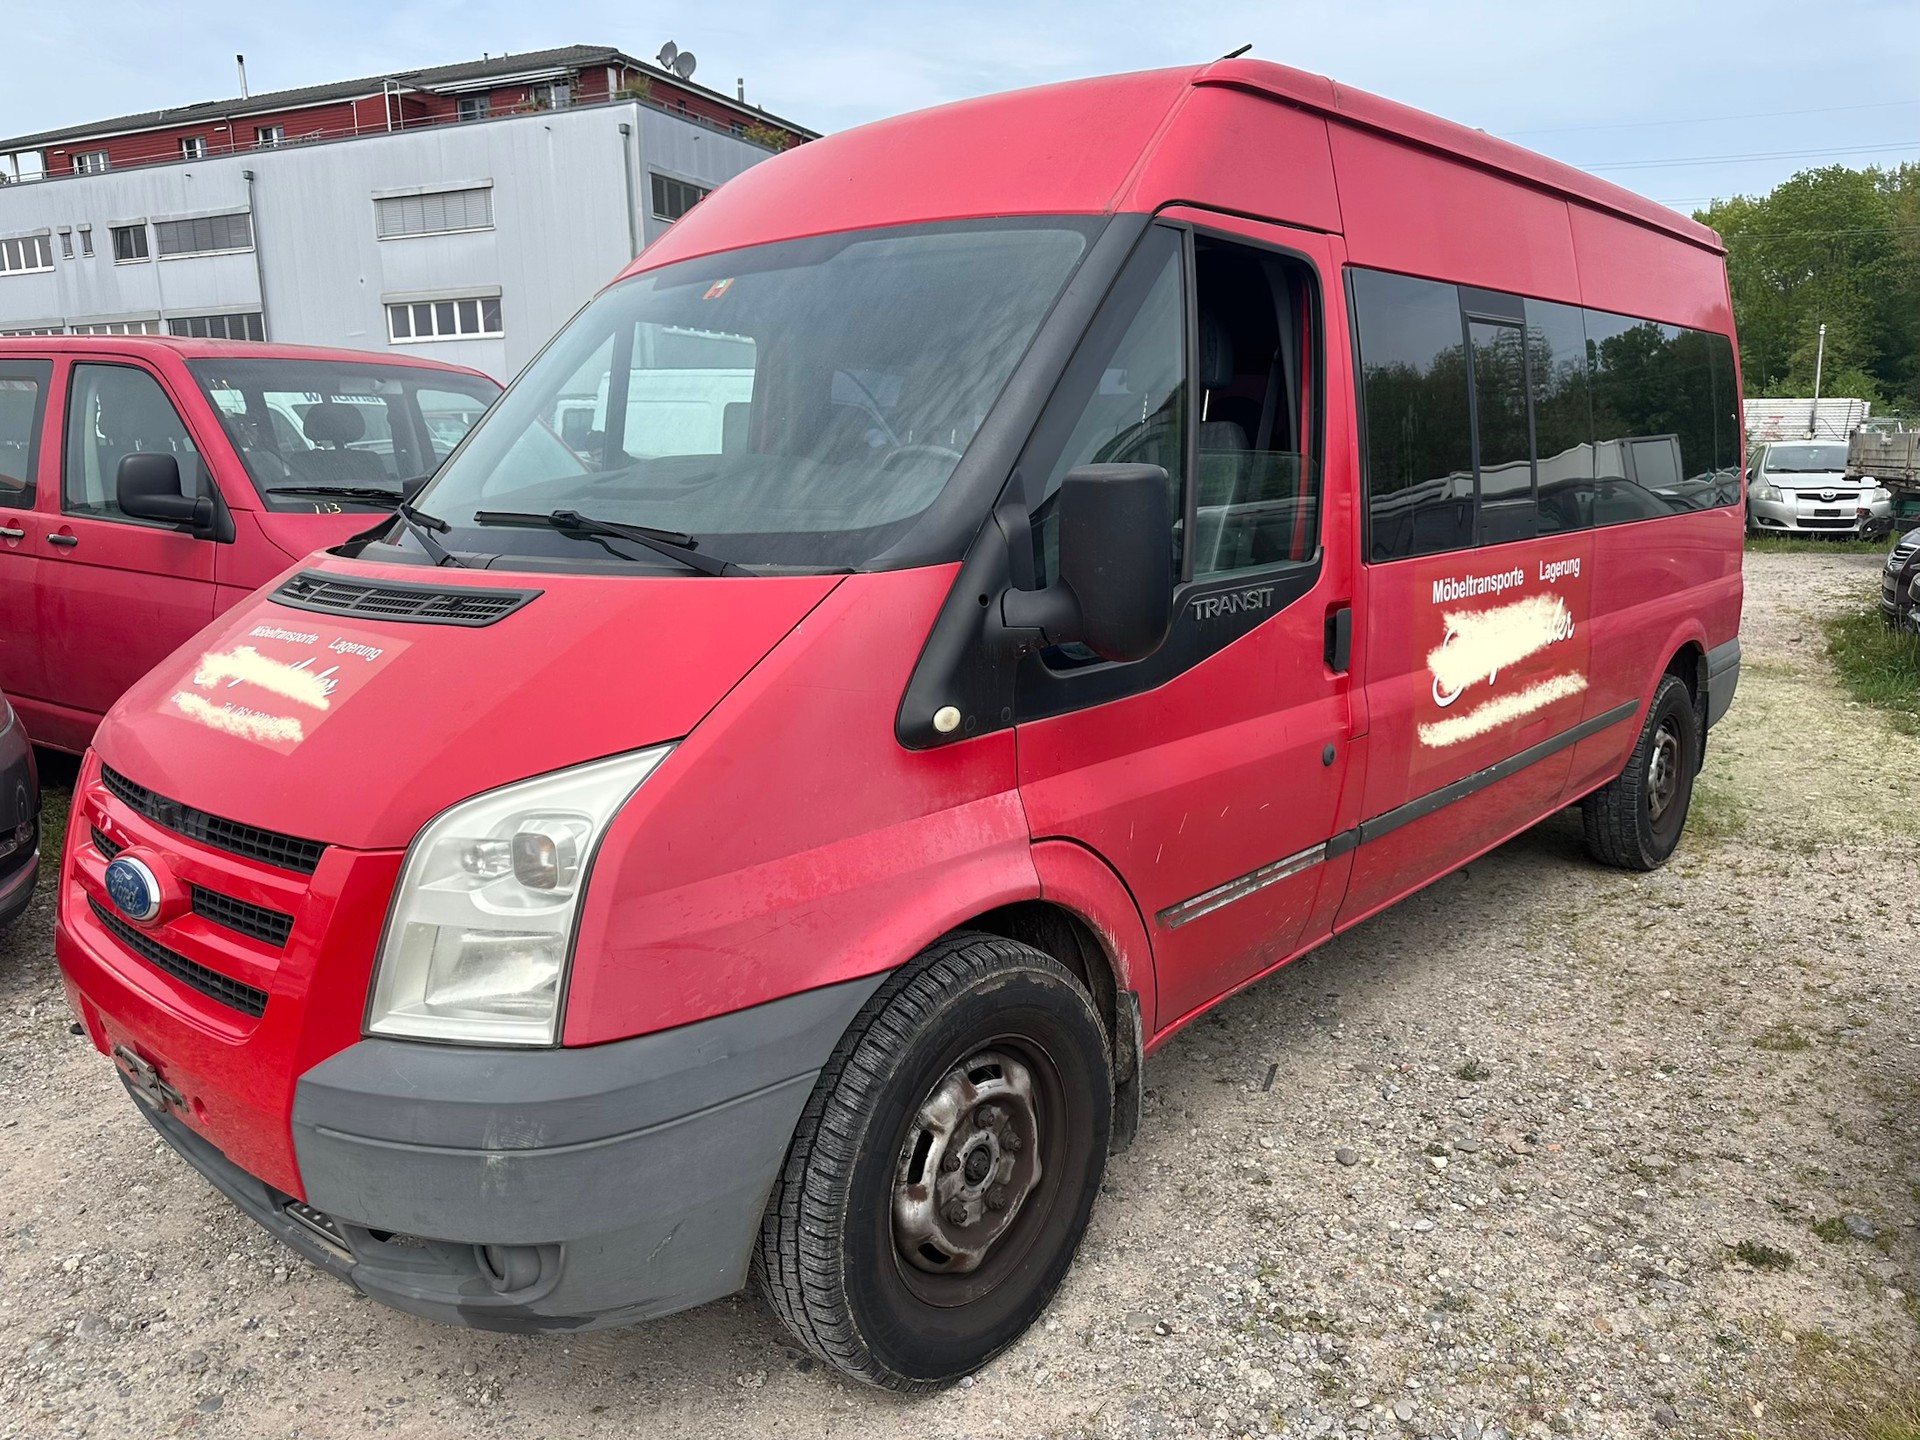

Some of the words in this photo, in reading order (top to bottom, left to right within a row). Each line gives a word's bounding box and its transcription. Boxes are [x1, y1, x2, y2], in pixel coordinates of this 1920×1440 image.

[1432, 567, 1524, 604] Möbeltransporte
[1539, 558, 1581, 583] Lagerung
[1191, 587, 1275, 620] TRANSIT
[249, 625, 319, 645] Möbeltransporte
[328, 637, 383, 661] Lagerung
[110, 864, 143, 911] Ford
